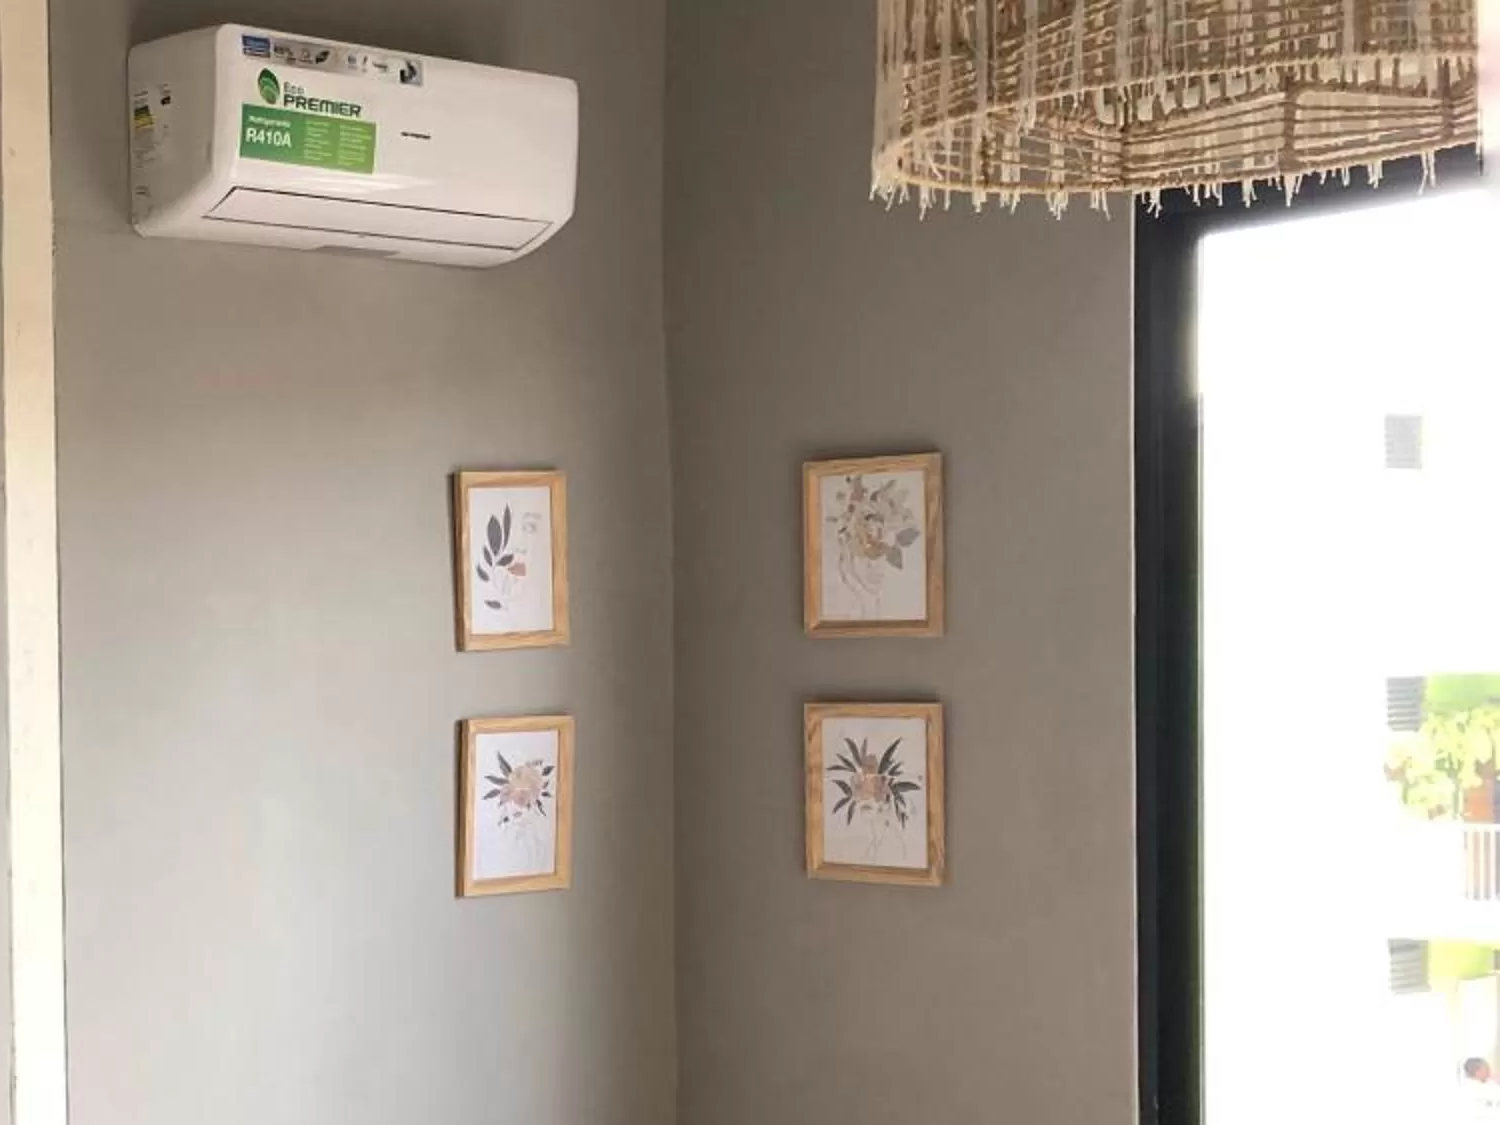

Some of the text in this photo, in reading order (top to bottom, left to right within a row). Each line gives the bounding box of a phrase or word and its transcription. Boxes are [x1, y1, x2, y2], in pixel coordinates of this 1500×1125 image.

[283, 81, 304, 94] Eco
[283, 94, 361, 117] PREMIER
[245, 127, 292, 148] R410A
